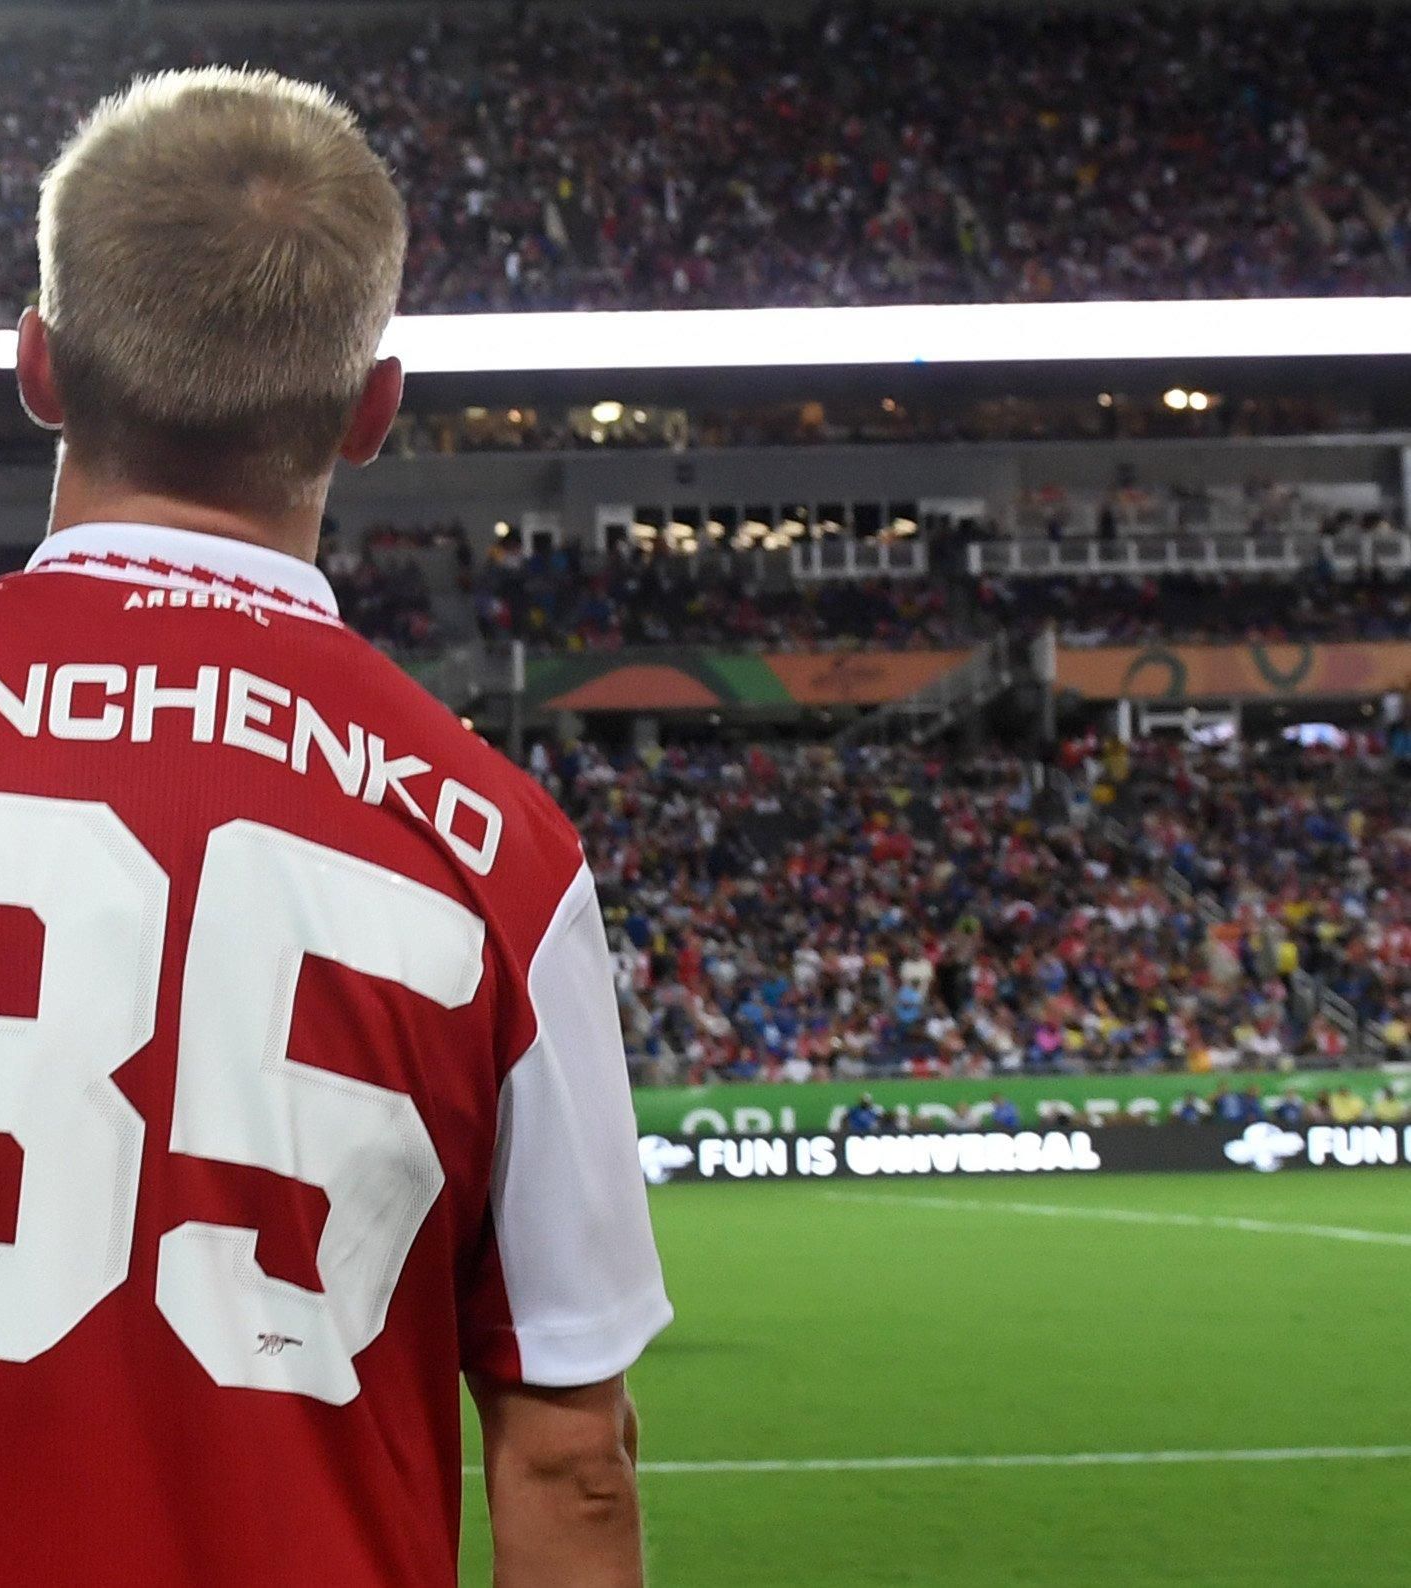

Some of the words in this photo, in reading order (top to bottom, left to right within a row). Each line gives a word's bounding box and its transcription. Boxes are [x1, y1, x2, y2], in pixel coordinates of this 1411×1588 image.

[123, 588, 271, 628] ARSENAL
[699, 1137, 788, 1177] FUN
[796, 1135, 837, 1176] IS
[1307, 1125, 1399, 1167] FUN
